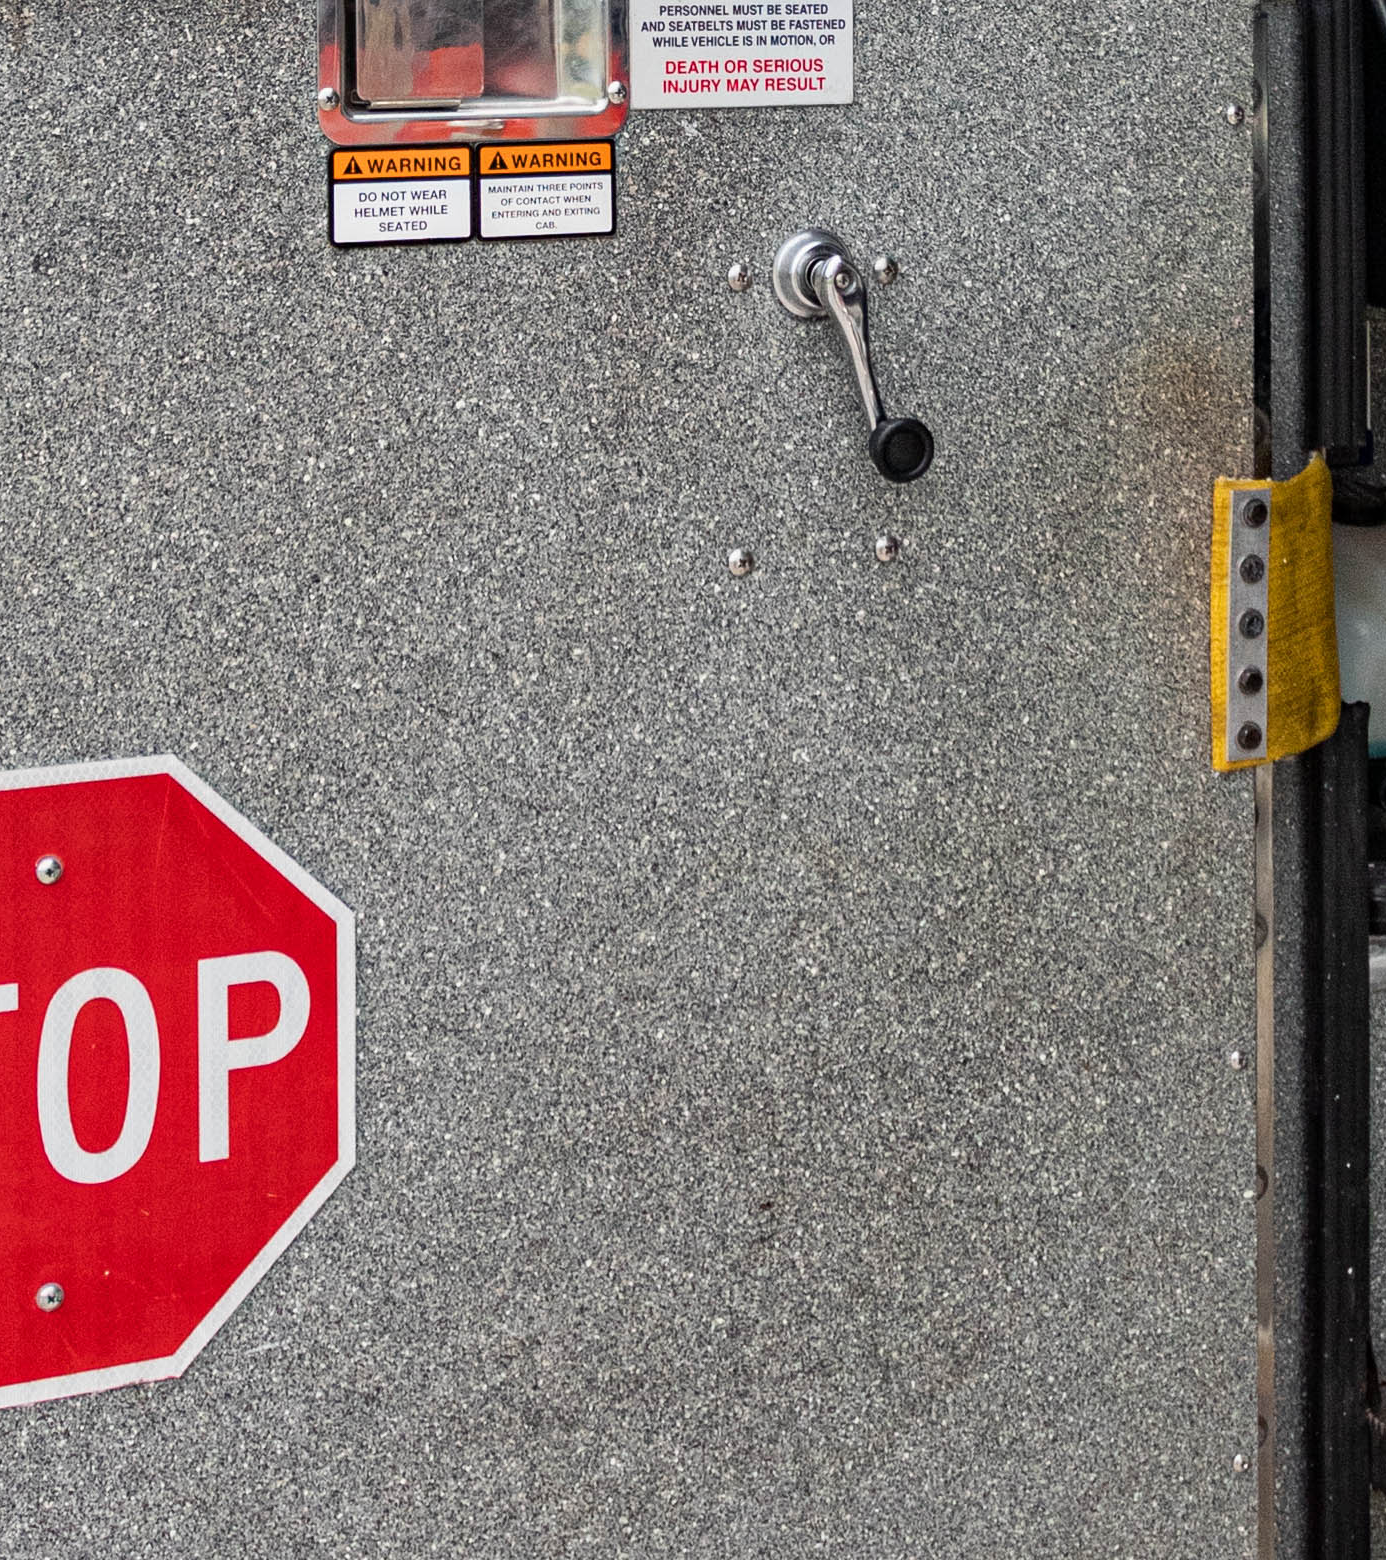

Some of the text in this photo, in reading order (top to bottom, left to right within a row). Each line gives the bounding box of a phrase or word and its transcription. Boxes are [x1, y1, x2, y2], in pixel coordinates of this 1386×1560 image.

[659, 3, 829, 17] PERSONNEL MUST BE SEATED
[641, 19, 846, 33] AND SEATBELTS MUST BE FASTENED
[652, 34, 836, 48] WHILE VEHICLE IS IN MOTION, OR
[665, 58, 824, 75] DEATH OR SERIOUS
[662, 77, 827, 94] INJURY MAY RESULT
[367, 156, 462, 173] WARNING
[511, 151, 602, 169] WARNING
[488, 182, 604, 194] MAINTAIN THREE POINTS
[358, 189, 447, 203] DO NOT WEAR
[500, 195, 592, 207] OF CONTACT WHEN
[354, 204, 449, 218] HELMET WHILE
[491, 207, 601, 220] ENTERING AND EXITING
[378, 220, 429, 233] SEATED
[535, 221, 558, 230] CAB.
